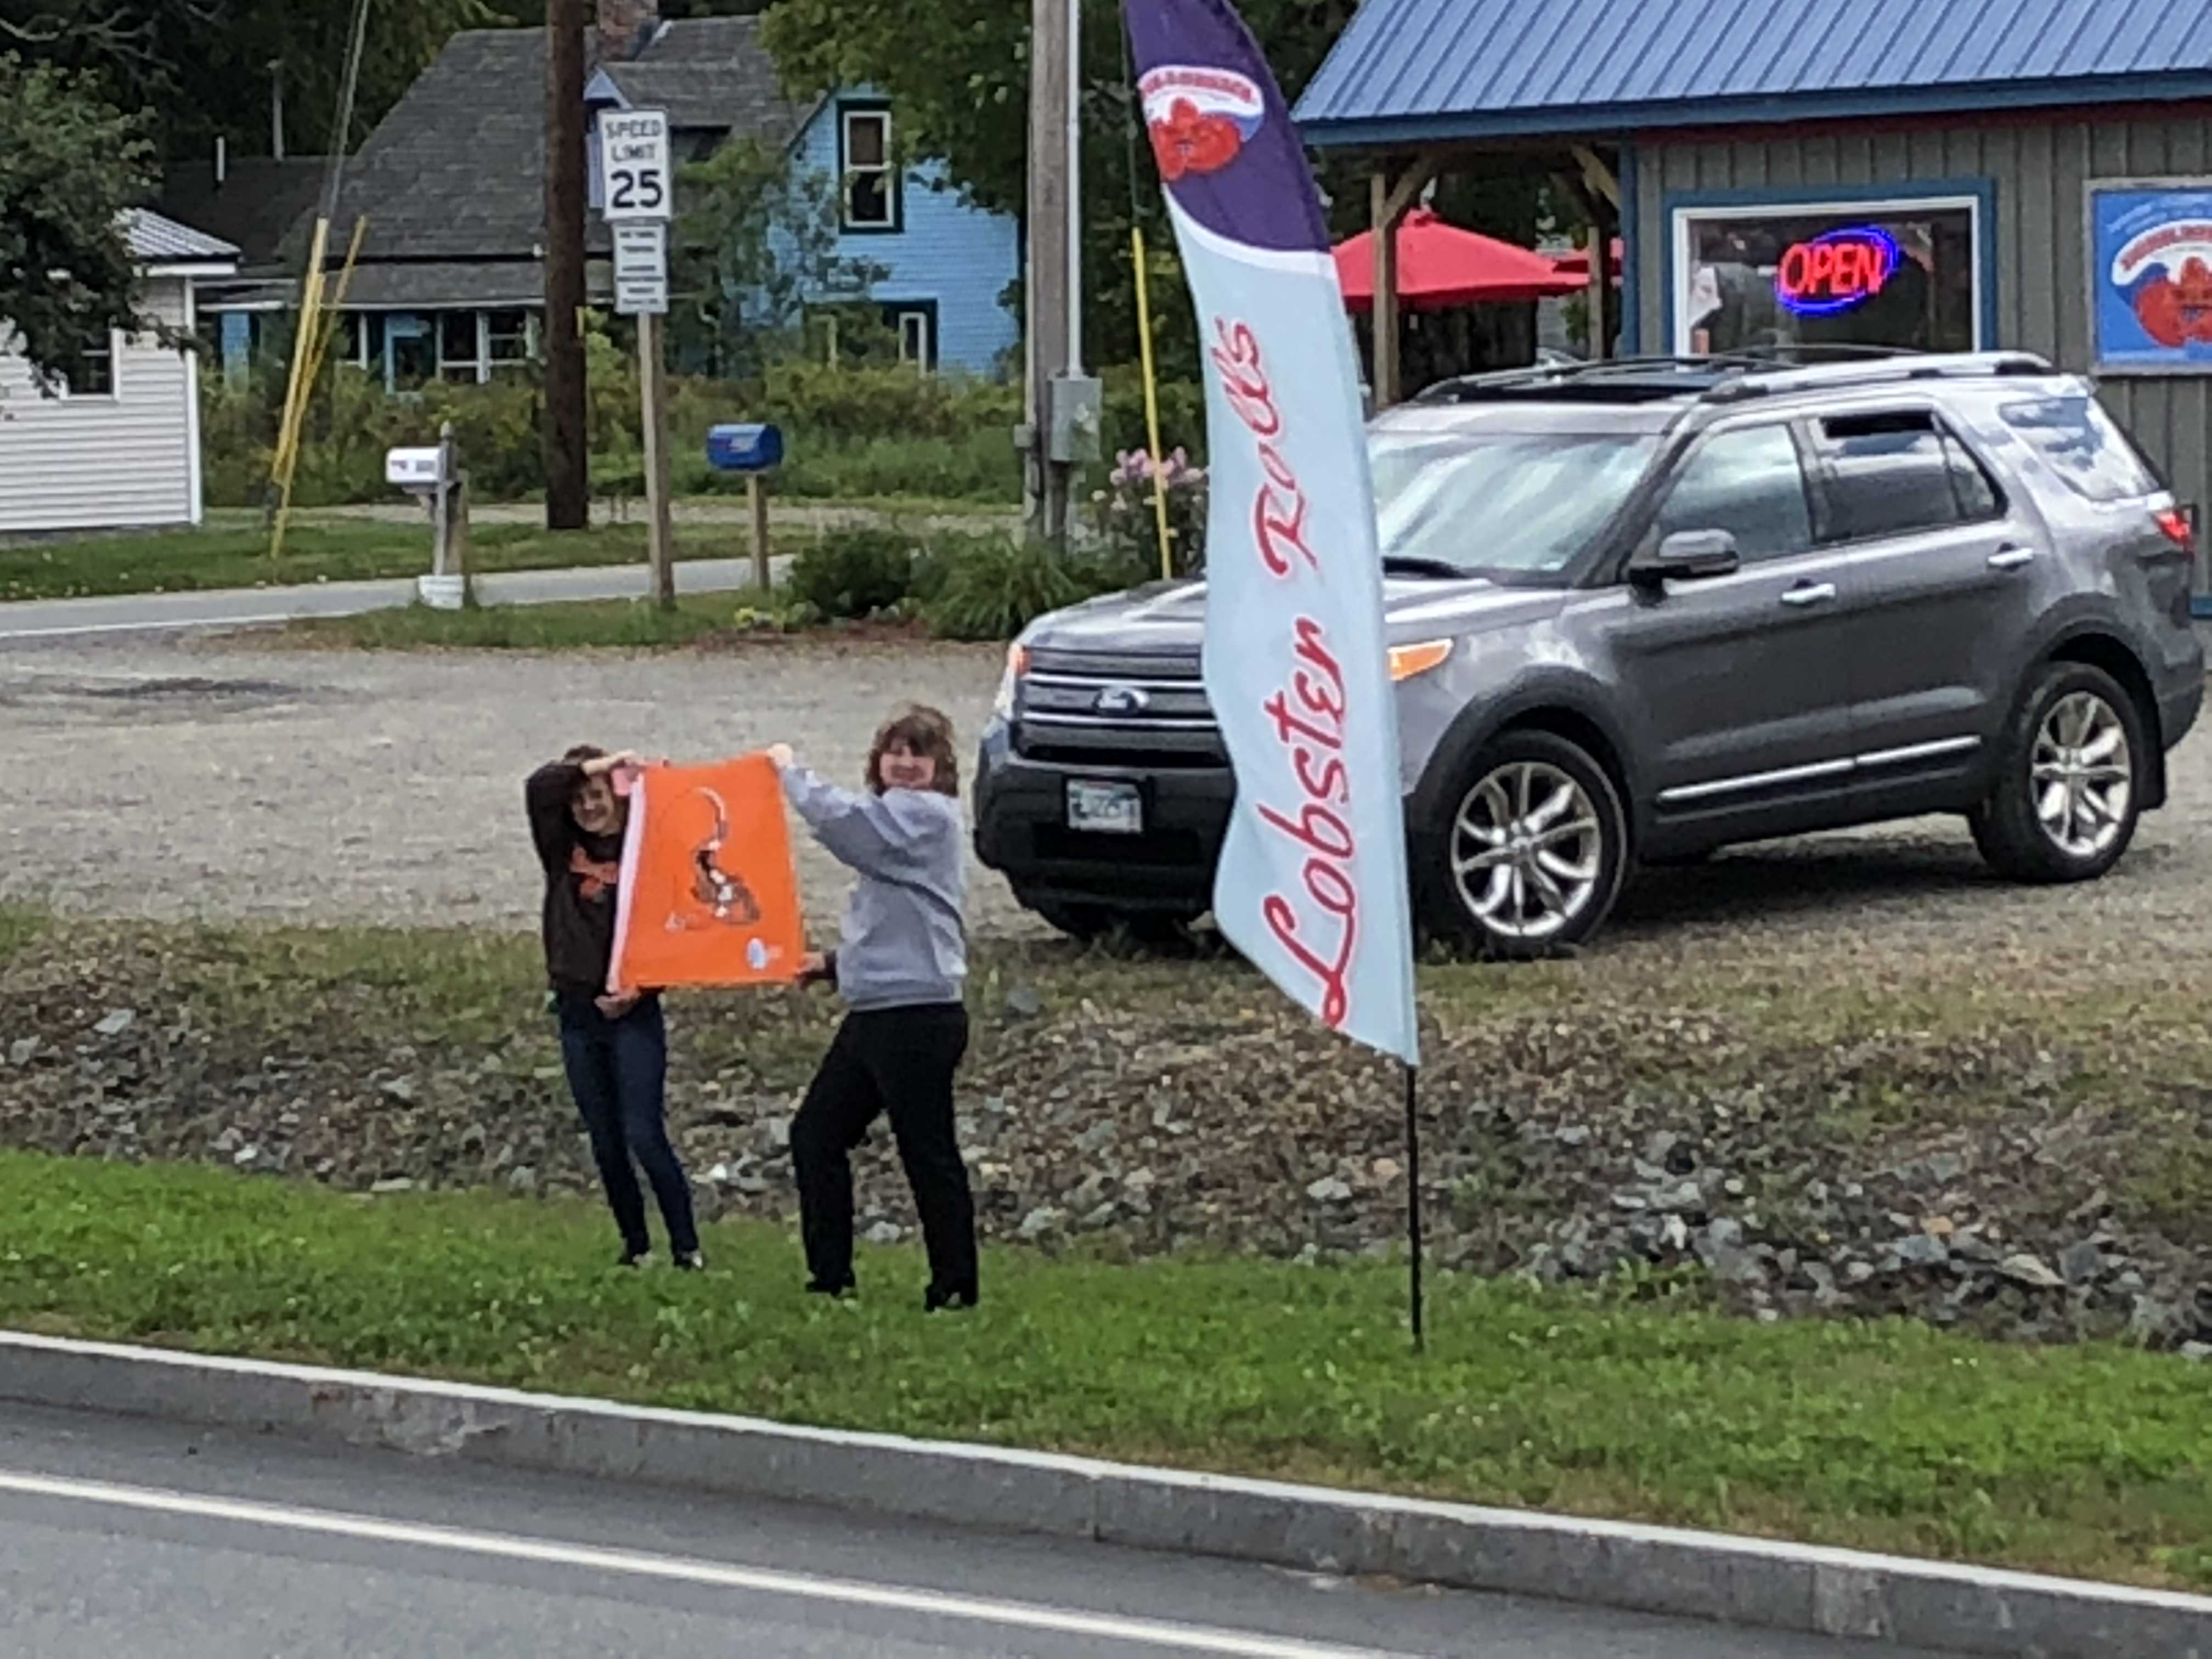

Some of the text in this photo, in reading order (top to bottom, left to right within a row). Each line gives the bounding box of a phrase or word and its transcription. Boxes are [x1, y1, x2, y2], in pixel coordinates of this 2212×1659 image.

[605, 120, 662, 139] SPEED
[611, 144, 657, 162] LIMIT
[611, 169, 663, 208] 25
[1780, 242, 1884, 295] OPEN
[1210, 316, 1356, 1028] Lobster Rolls
